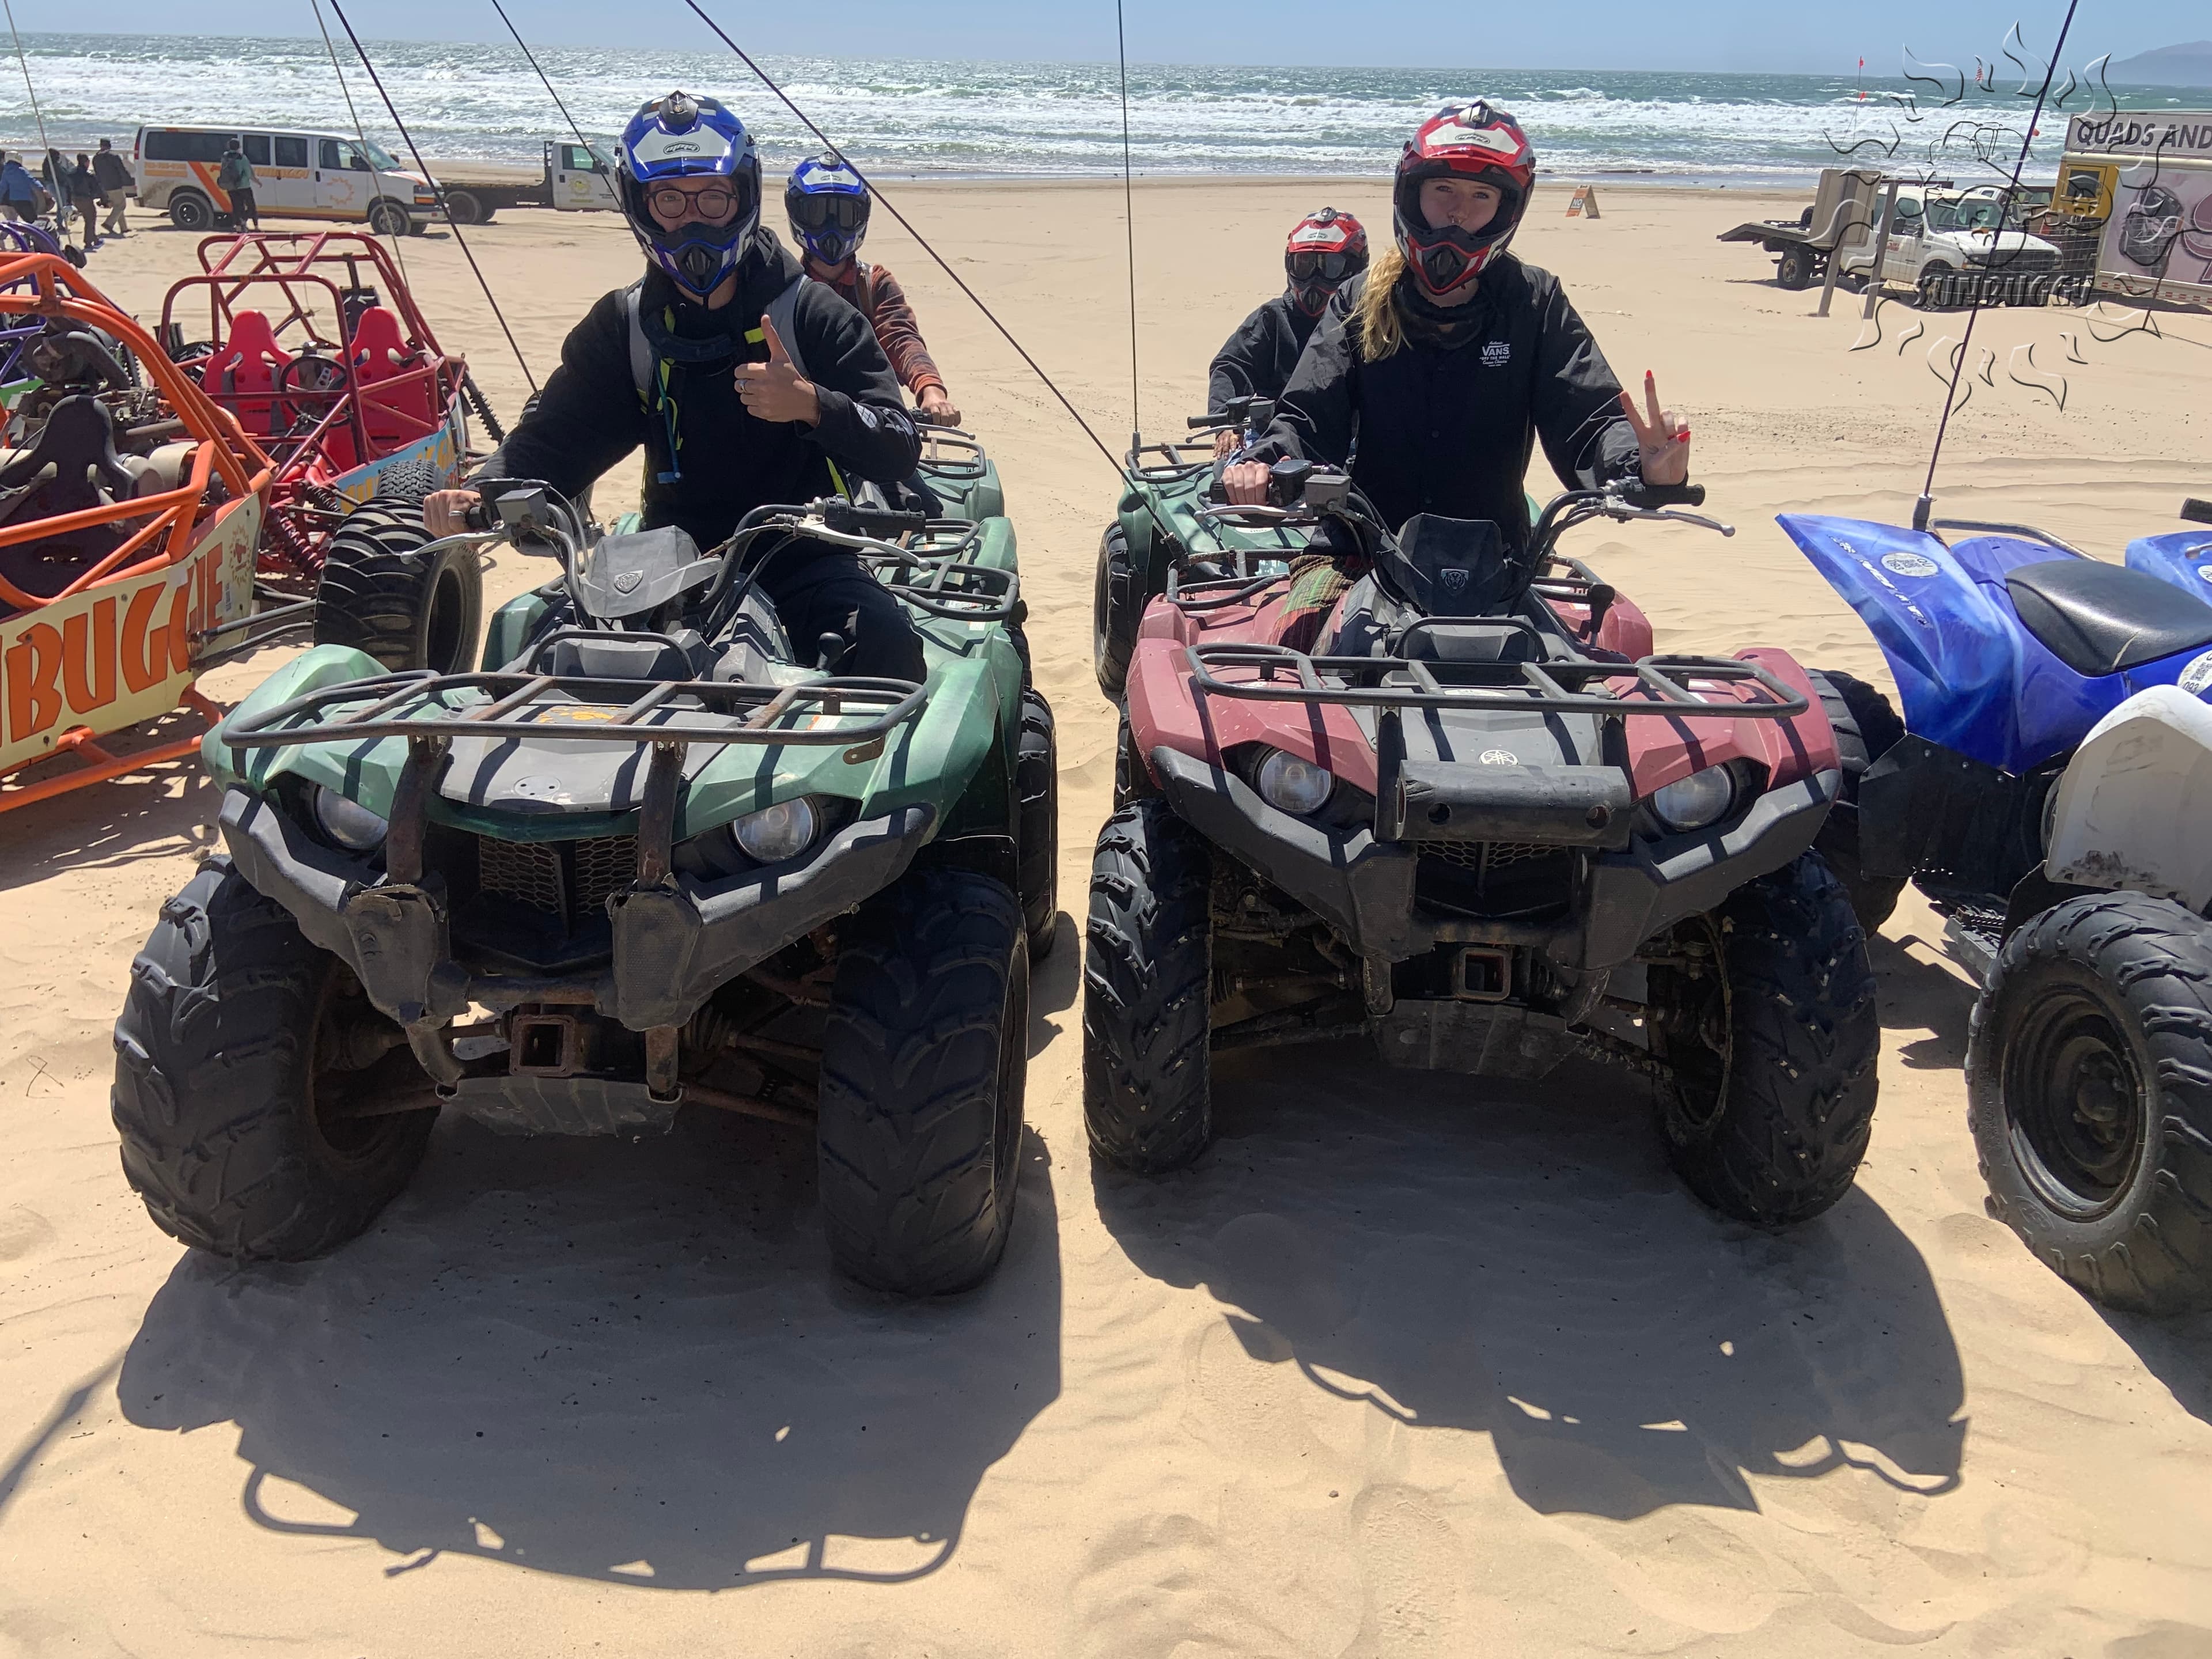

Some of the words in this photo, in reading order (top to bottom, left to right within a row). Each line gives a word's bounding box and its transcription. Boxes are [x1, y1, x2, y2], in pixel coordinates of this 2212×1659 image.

[2077, 120, 2156, 146] QUADS
[2160, 124, 2212, 149] AND
[1572, 198, 1583, 206] NO
[1482, 344, 1510, 356] VANS
[1886, 559, 1904, 571] 093
[0, 542, 223, 748] BUGGIE
